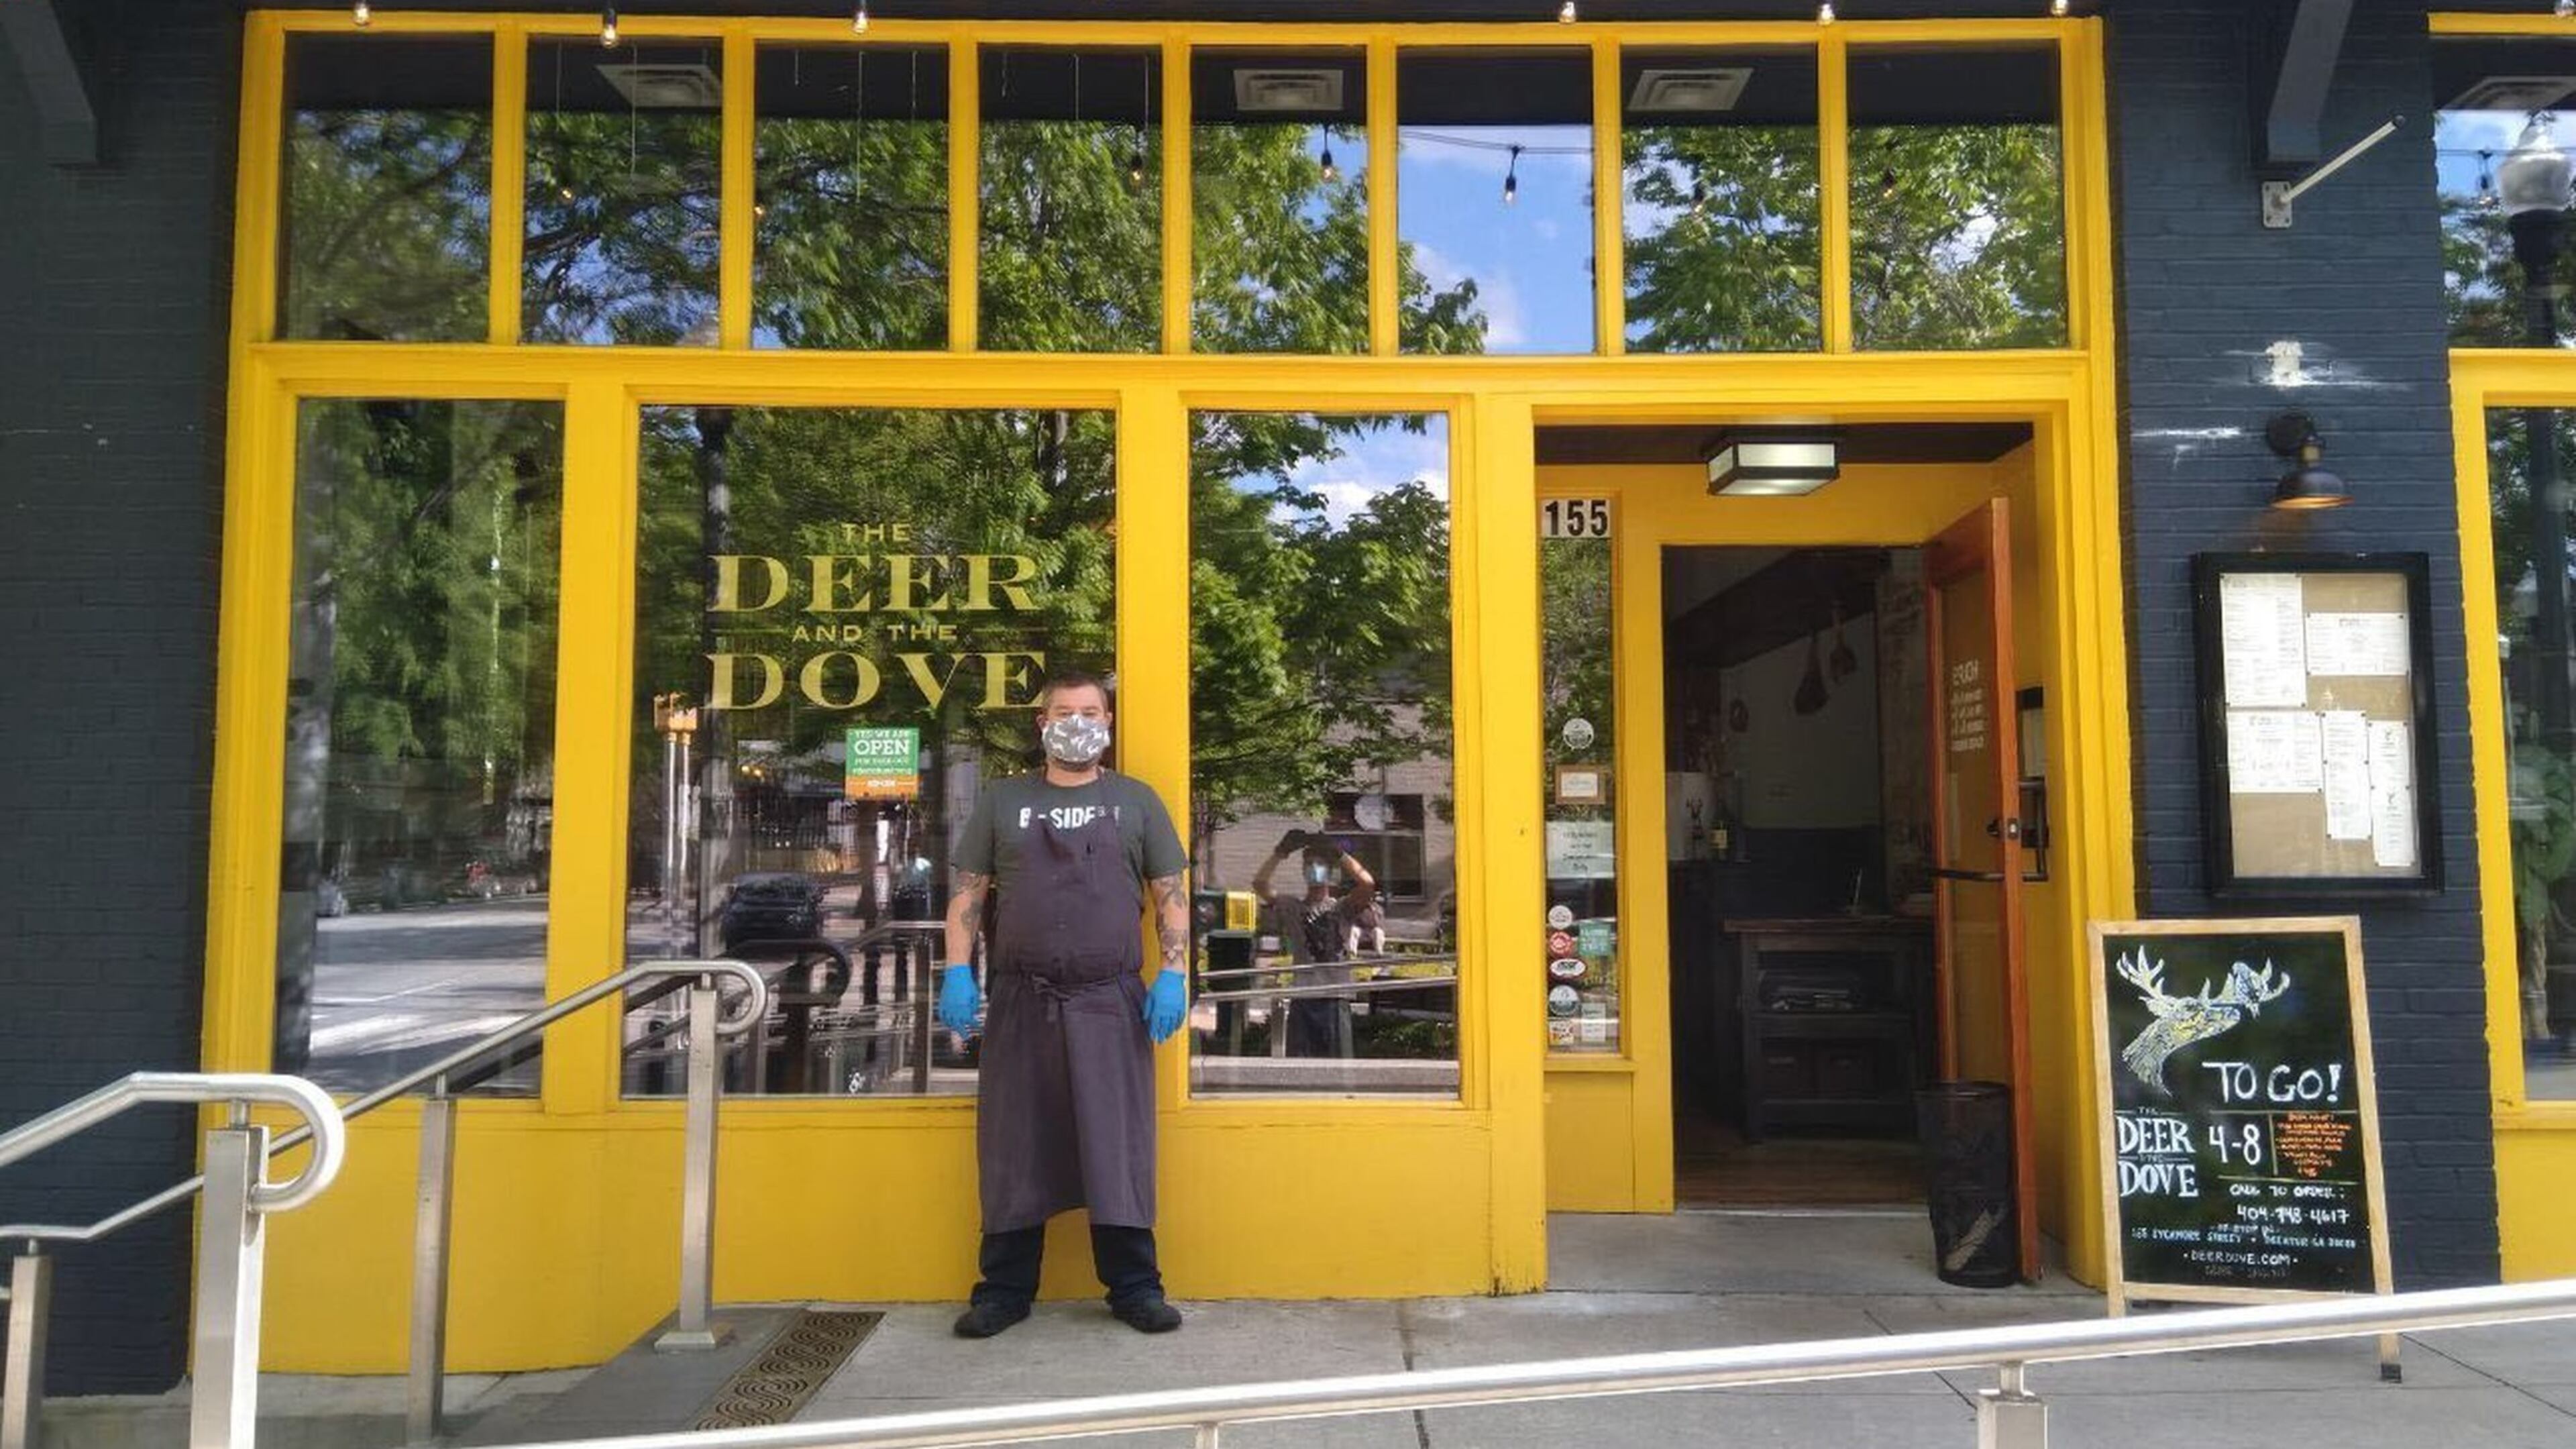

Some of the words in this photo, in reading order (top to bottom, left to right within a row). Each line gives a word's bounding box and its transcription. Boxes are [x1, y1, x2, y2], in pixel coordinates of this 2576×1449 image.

[842, 523, 911, 542] THE
[1545, 499, 1608, 536] 155
[706, 554, 1040, 612] DEER
[792, 625, 863, 642] AND
[887, 624, 957, 641] THE
[701, 651, 1046, 710] DOVE
[855, 739, 909, 755] OPEN
[2202, 1062, 2257, 1103] TO
[2267, 1064, 2341, 1102] GO!
[2116, 1116, 2196, 1153] DEER
[2208, 1124, 2261, 1165] 4-8
[2118, 1160, 2199, 1197] DOVE
[2269, 1185, 2288, 1197] TO
